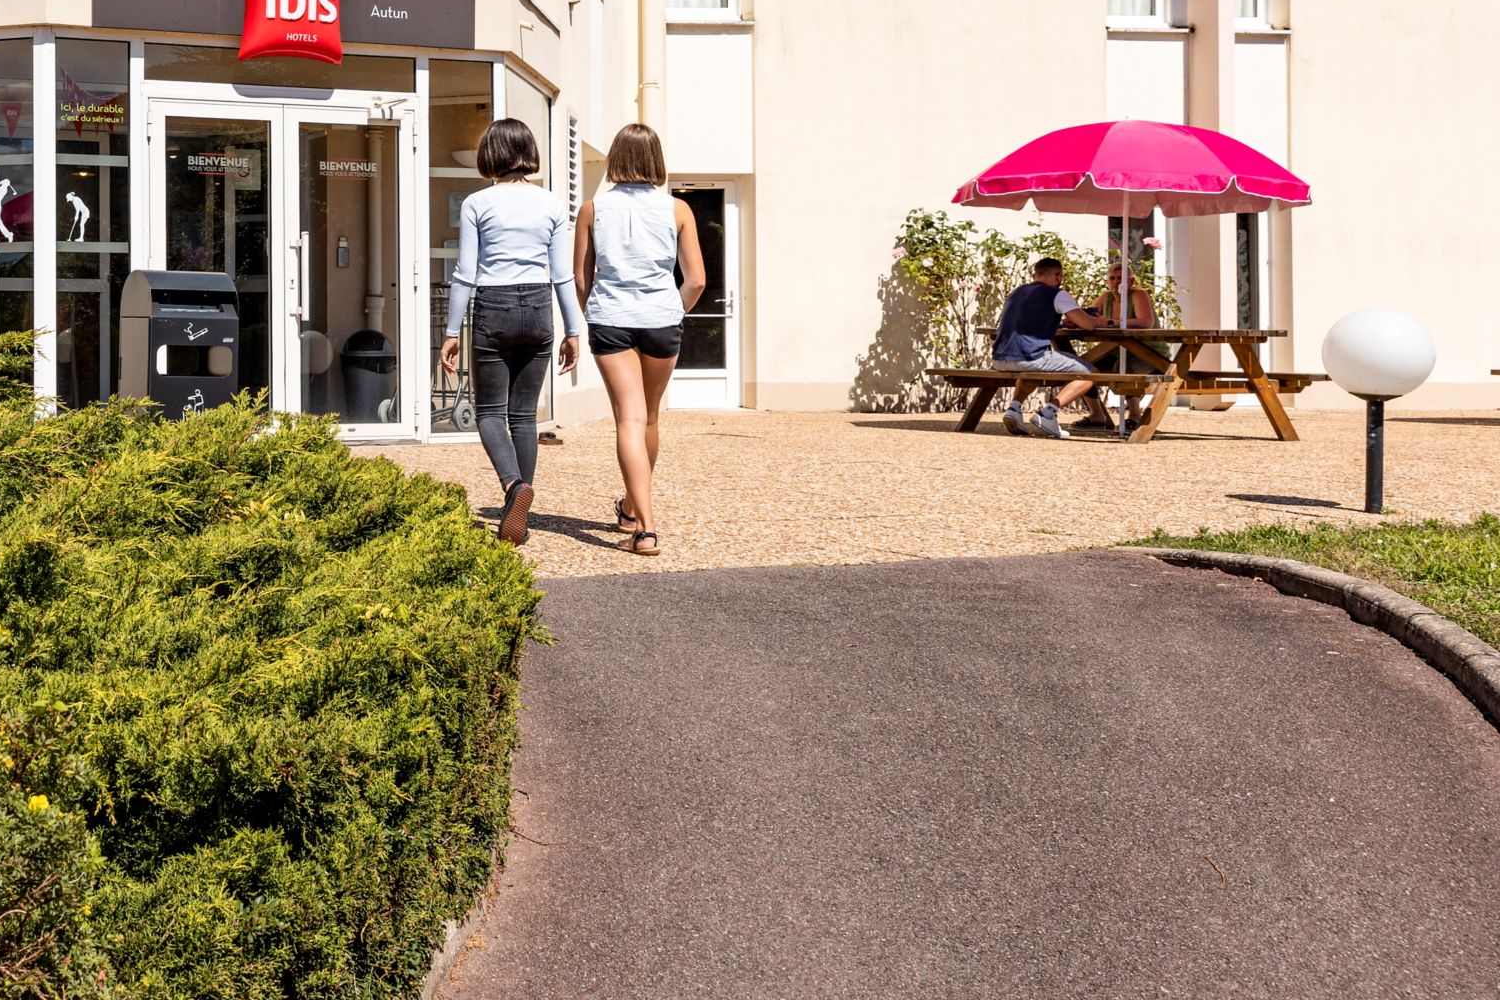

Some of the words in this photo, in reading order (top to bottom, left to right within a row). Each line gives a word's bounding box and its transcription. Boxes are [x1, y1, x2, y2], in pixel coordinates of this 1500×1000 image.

[371, 5, 408, 19] Autun
[286, 33, 317, 42] HOTELS
[60, 103, 74, 112] Ici,
[76, 103, 86, 112] le
[87, 103, 124, 113] durable
[187, 155, 249, 167] BIENVENUE
[319, 161, 378, 172] BIENVENUE
